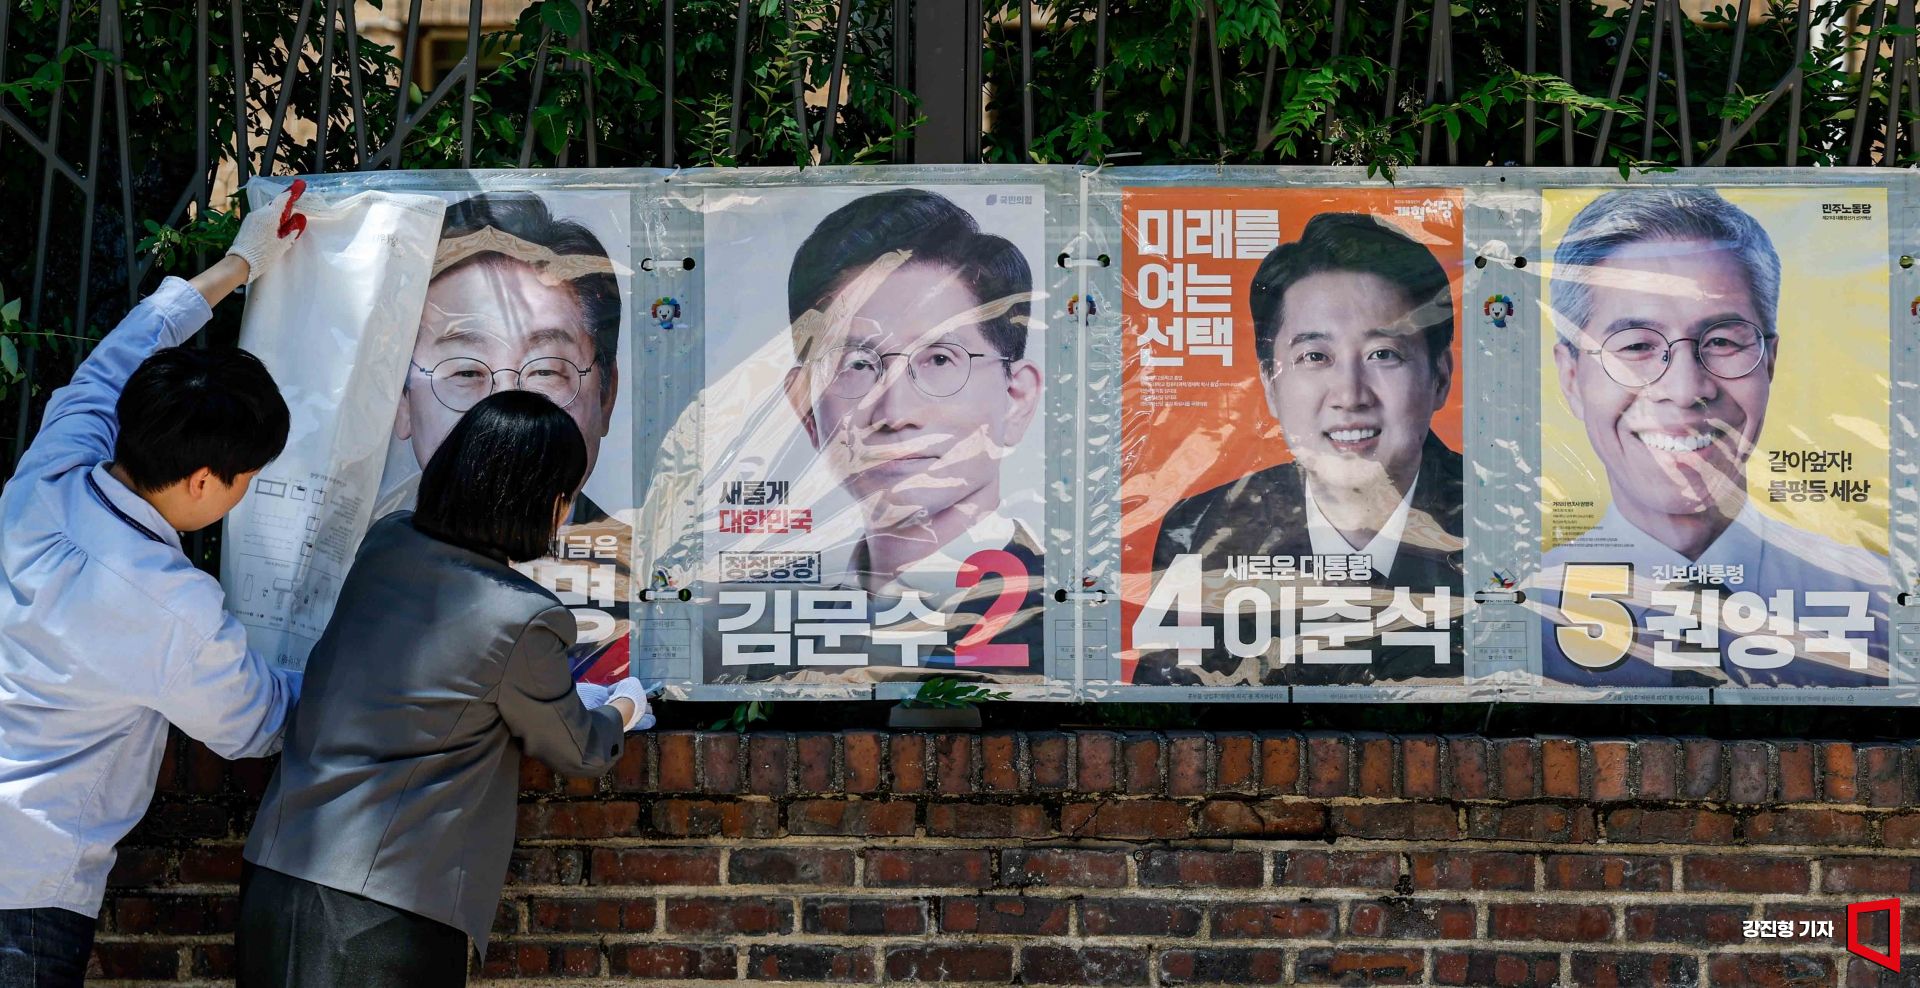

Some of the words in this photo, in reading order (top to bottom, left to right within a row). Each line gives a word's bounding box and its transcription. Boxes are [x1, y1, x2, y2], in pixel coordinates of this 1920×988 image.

[1000, 195, 1032, 205] 국민의힘
[1394, 198, 1454, 222] 개혁신당
[1822, 203, 1872, 214] 민주노동당
[1137, 209, 1280, 260] 미래를
[1137, 263, 1232, 312] 여는
[1136, 316, 1233, 367] 선택
[1768, 449, 1852, 473] 갈아엎자!
[719, 480, 789, 505] 새롭게
[1768, 479, 1828, 503] 불평등
[1830, 479, 1871, 503] 세상
[719, 508, 813, 534] 대한민국
[725, 555, 815, 579] 정정당당
[1223, 554, 1296, 581] 새로운
[1299, 554, 1373, 581] 대통령
[1651, 564, 1745, 584] 진보대통령
[954, 549, 1030, 667] 2
[1132, 553, 1215, 666] 4
[1554, 561, 1635, 673] 5
[718, 589, 948, 667] 김문수
[1223, 585, 1451, 665] 이준석
[1645, 589, 1875, 669] 권영국
